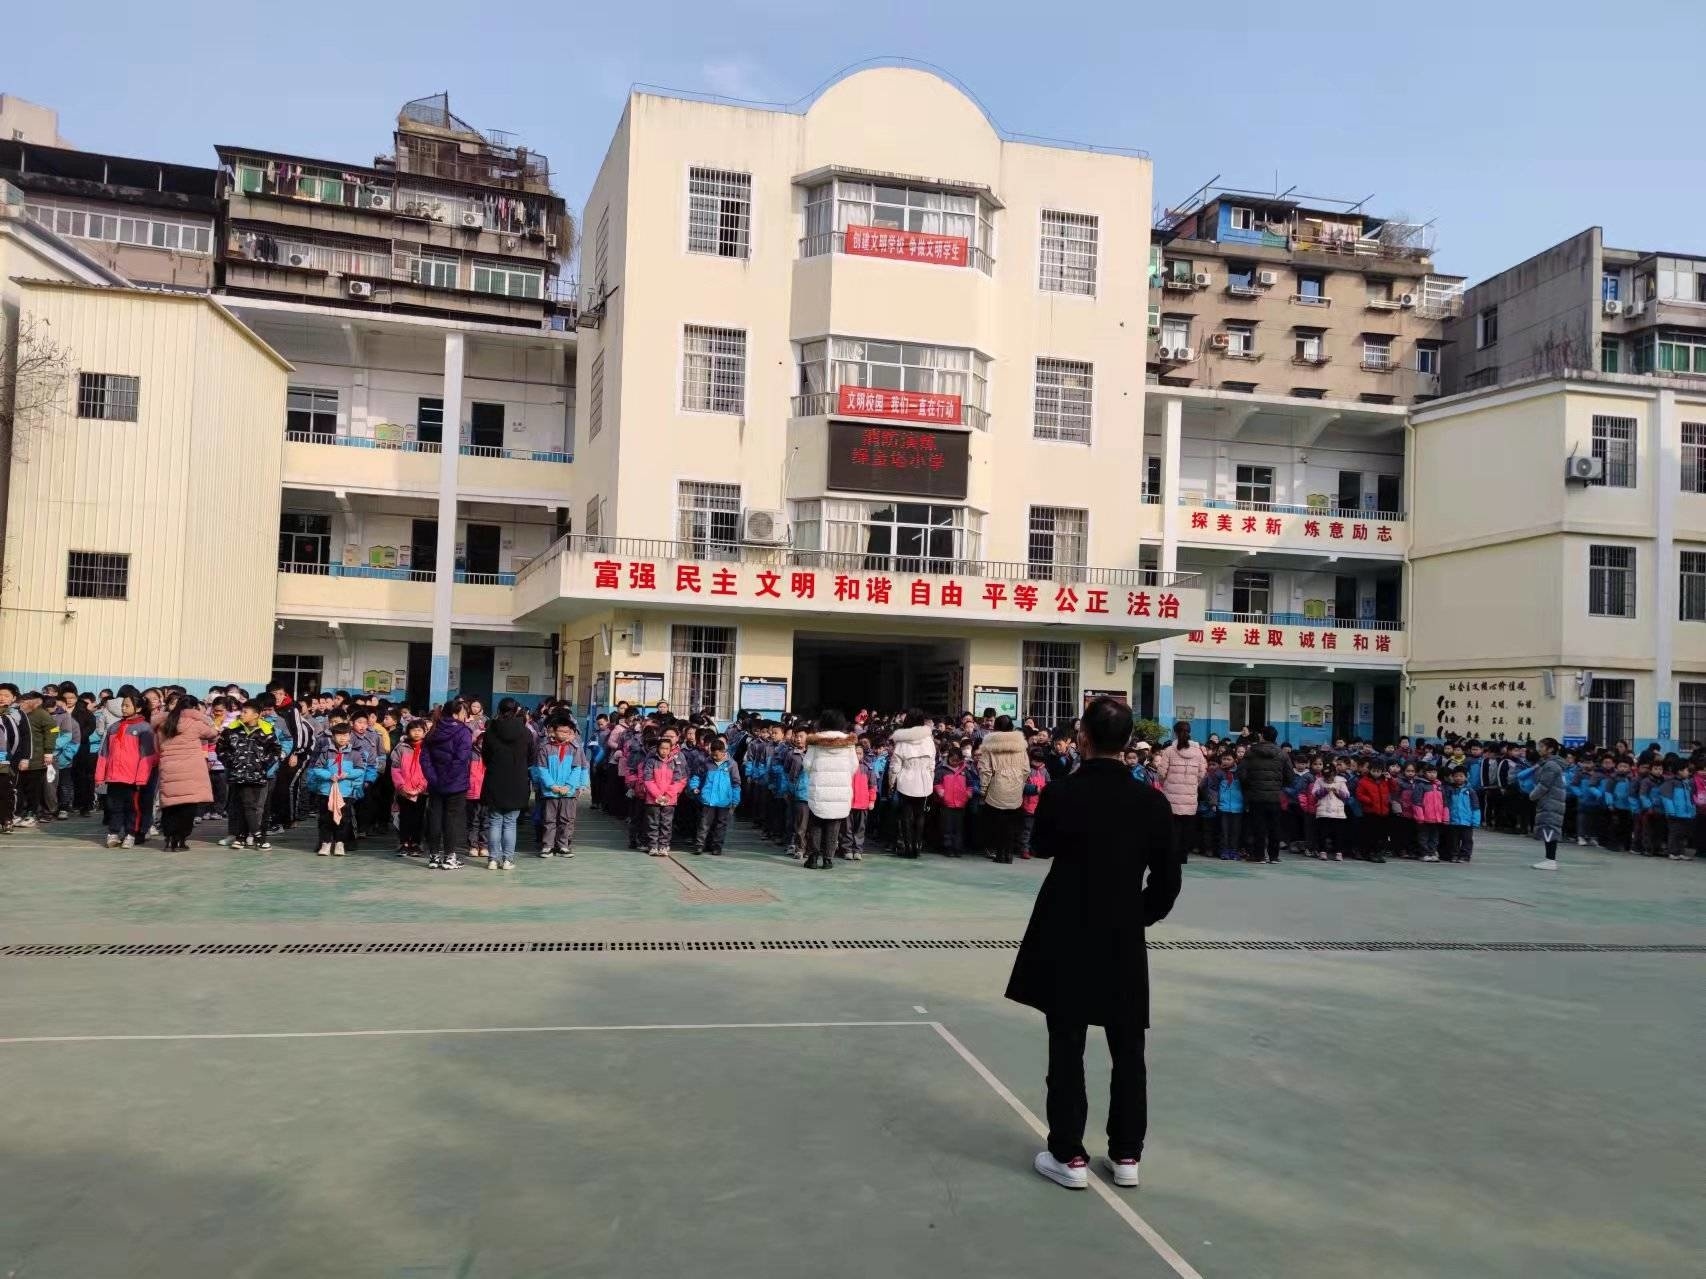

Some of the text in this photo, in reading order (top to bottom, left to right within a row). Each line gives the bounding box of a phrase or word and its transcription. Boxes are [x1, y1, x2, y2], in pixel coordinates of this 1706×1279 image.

[853, 231, 960, 261] 创建文明学校 争做文明学生
[847, 391, 954, 419] 文明校园 我们一直在行动
[1191, 511, 1393, 543] 探美求新 炼意励志
[593, 560, 1181, 619] 富强 民主 文明 和谐 自由 平等 公正 法治
[1188, 627, 1392, 653] 勤学 进取 诚信 和谐
